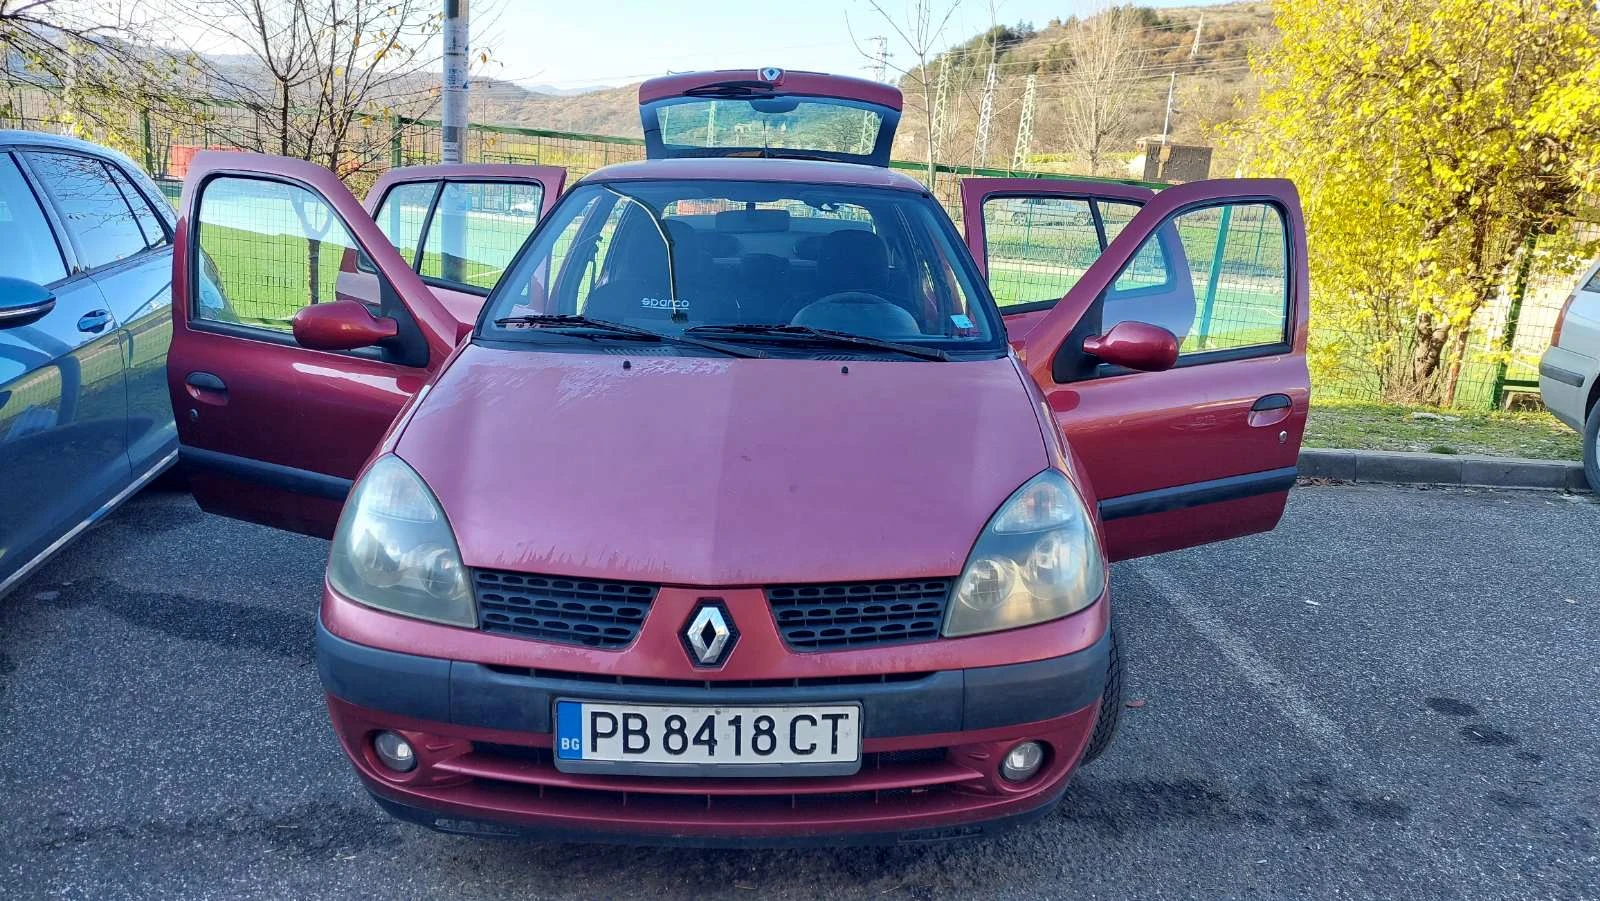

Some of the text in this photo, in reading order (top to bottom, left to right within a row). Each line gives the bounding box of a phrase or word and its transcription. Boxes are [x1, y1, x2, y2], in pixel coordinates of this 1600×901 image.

[641, 298, 690, 309] sparco
[590, 711, 849, 756] PB 8418 CT
[560, 737, 580, 751] BG
